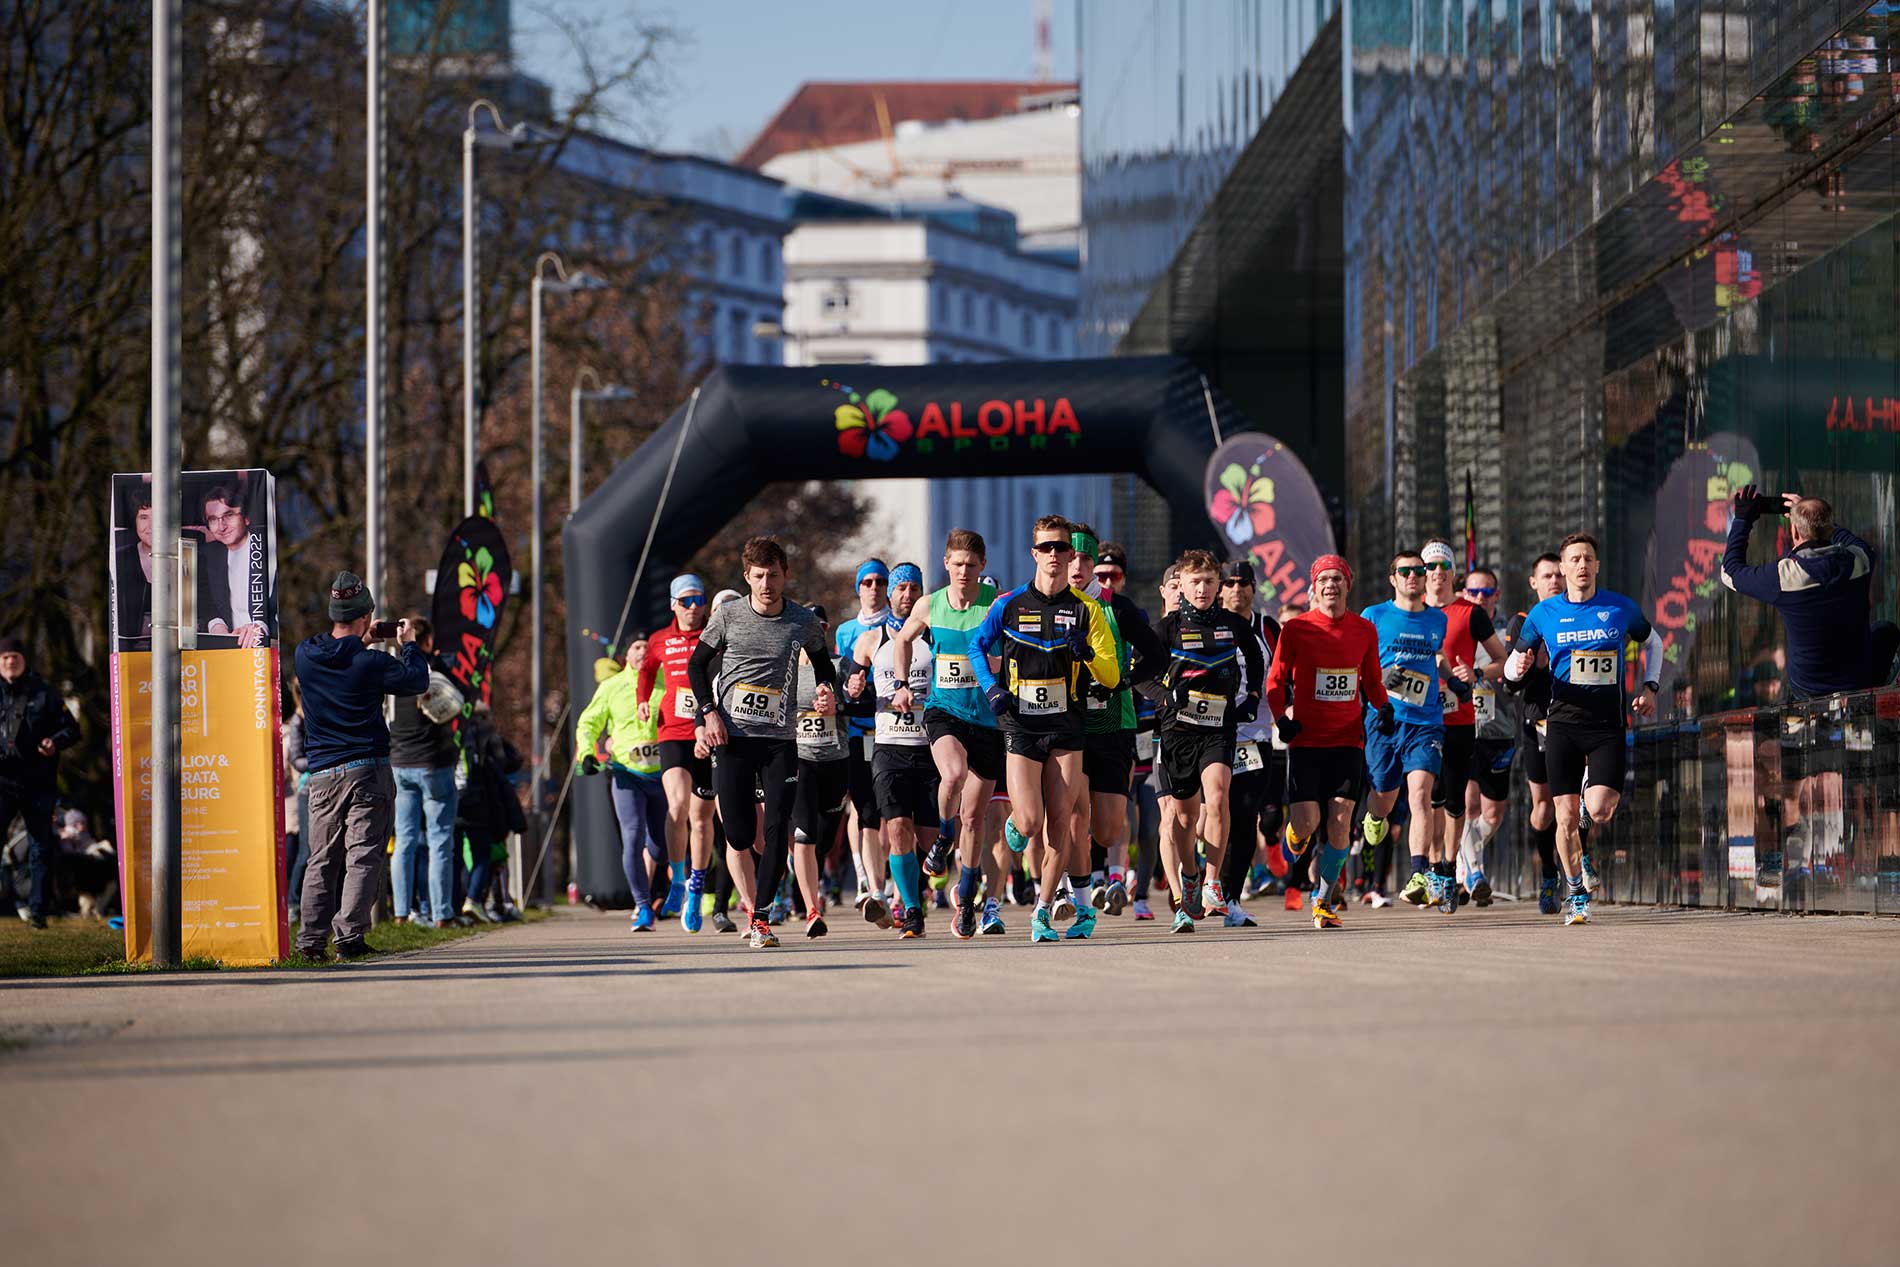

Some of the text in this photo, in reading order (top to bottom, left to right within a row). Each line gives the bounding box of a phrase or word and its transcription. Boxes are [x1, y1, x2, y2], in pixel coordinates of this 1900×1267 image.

[916, 397, 1081, 438] ALOHA
[916, 433, 1081, 453] SPORT
[250, 534, 267, 728] SONNTAGSMATINEEN 2022
[1556, 628, 1609, 644] EREMA
[1392, 638, 1432, 648] AUSTRIA
[949, 662, 960, 677] 5
[1576, 657, 1613, 673] 113
[884, 669, 927, 679] ERGER
[940, 675, 976, 683] RAPHAEL
[1326, 675, 1348, 690] 38
[1403, 676, 1425, 694] 10
[1035, 687, 1048, 703] 8
[1316, 689, 1355, 697] ALEXANDER
[684, 695, 694, 708] 5
[742, 693, 769, 710] 49
[1028, 700, 1059, 710] NIKLAS
[1196, 700, 1209, 714] 6
[1475, 696, 1484, 709] 3
[734, 706, 775, 719] ANDREAS
[892, 711, 914, 726] 79
[1179, 710, 1222, 721] KONSTANTIN
[802, 718, 825, 732] 29
[889, 725, 921, 733] RONALD
[797, 729, 834, 739] SUSANNE
[140, 754, 229, 769] KLIOV &
[140, 771, 220, 785] CRATA
[141, 787, 220, 801] SBURG
